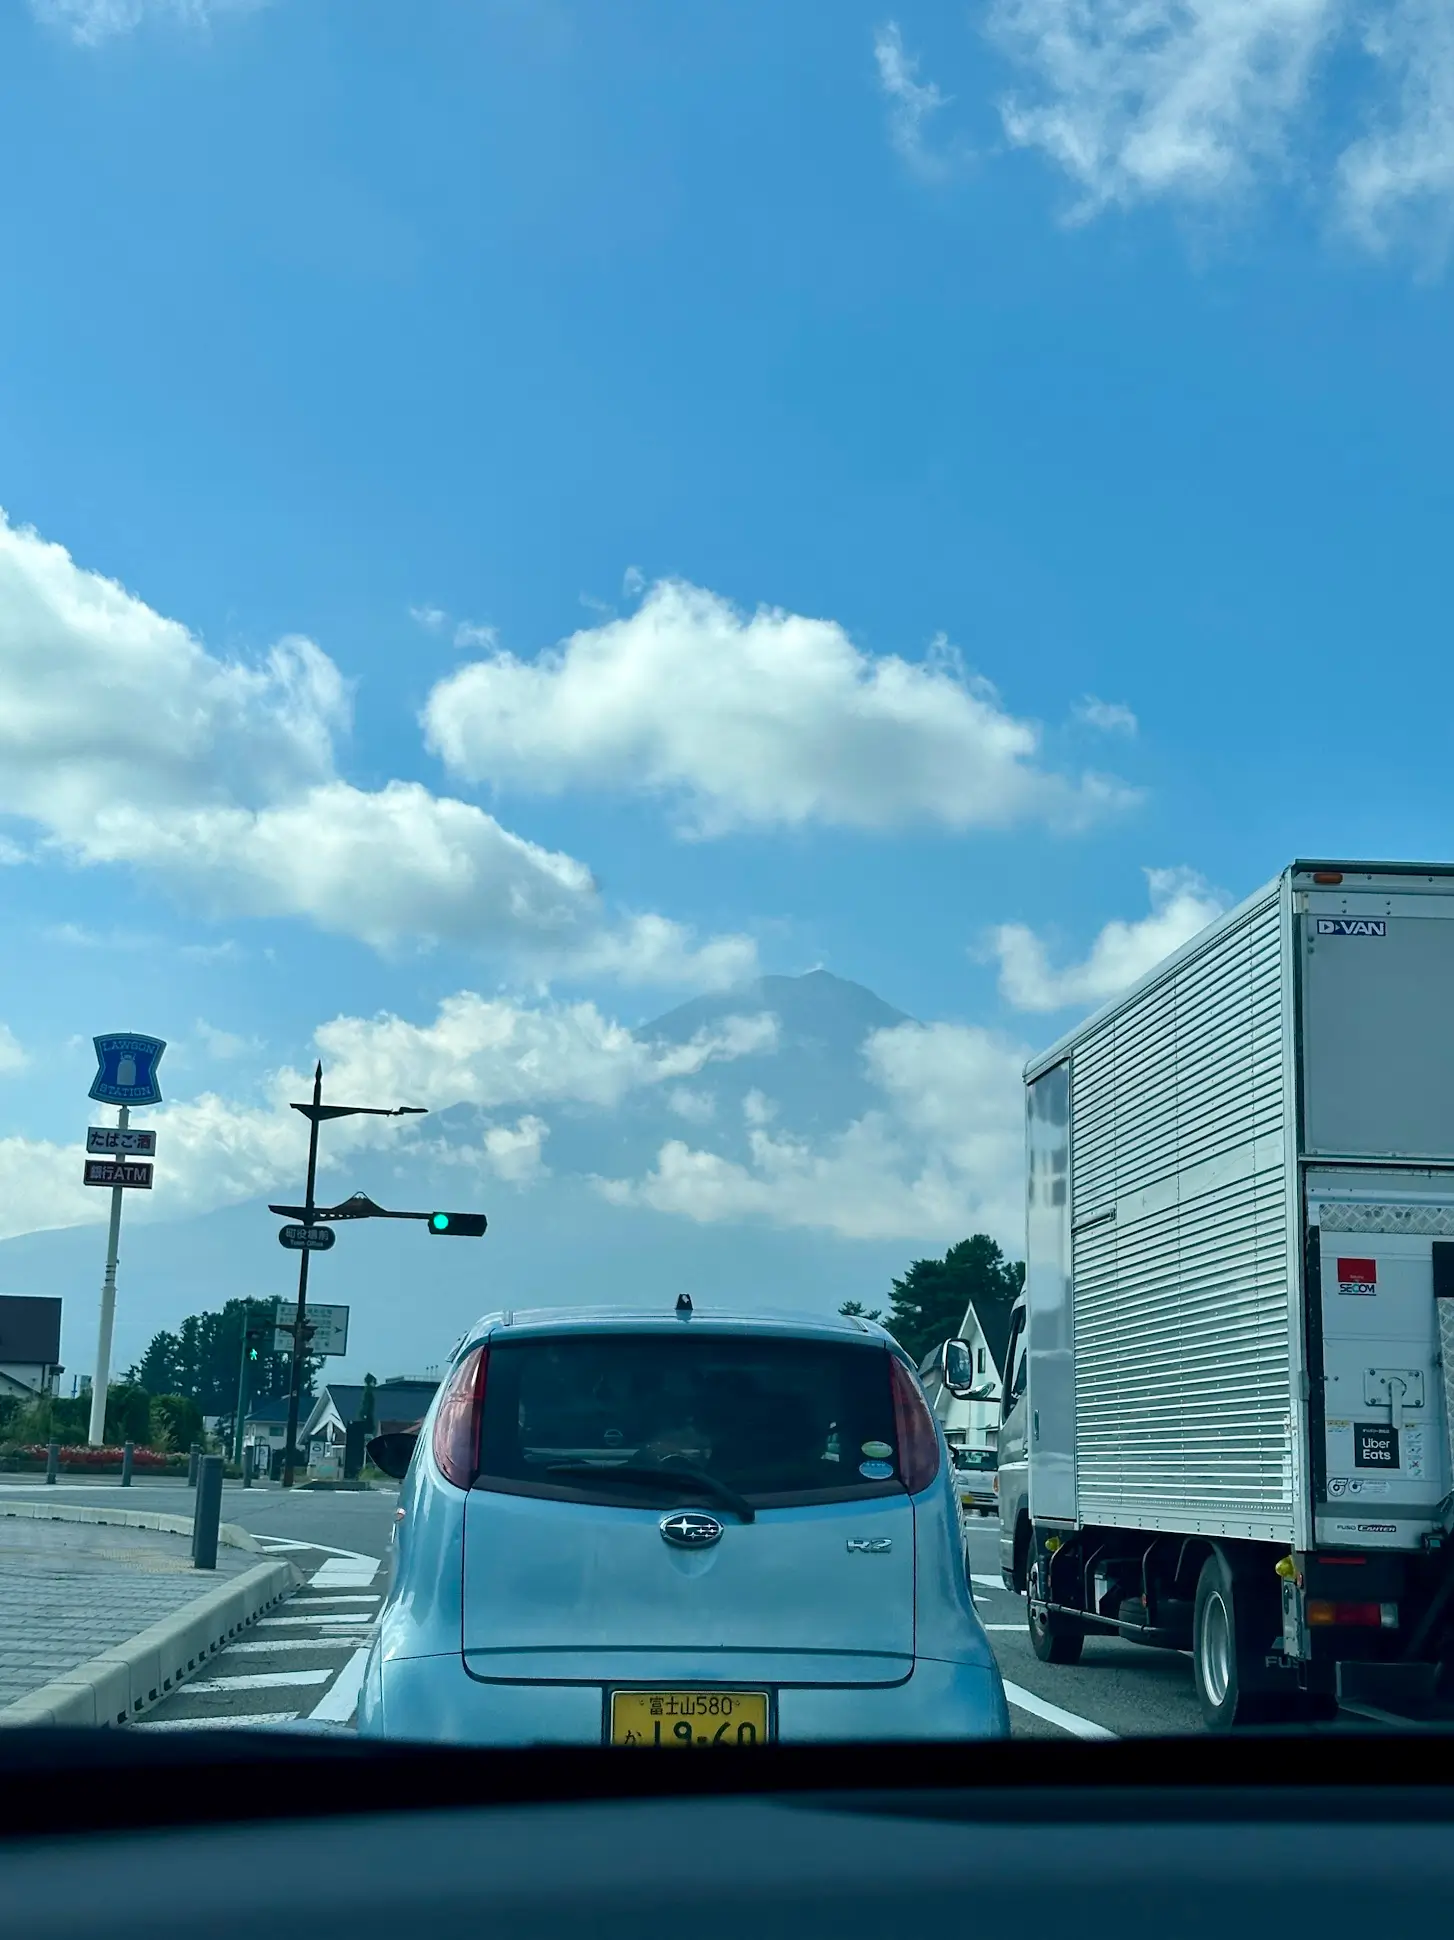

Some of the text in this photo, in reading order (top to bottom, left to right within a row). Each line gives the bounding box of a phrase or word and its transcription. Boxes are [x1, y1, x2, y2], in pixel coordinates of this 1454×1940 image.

[102, 1039, 157, 1054] LAWSON
[99, 1083, 151, 1097] STATION
[90, 1165, 147, 1181] 銀行ATM
[1339, 1283, 1375, 1294] SECOM
[1362, 1437, 1390, 1449] Uber
[1362, 1449, 1391, 1460] Eats
[846, 1538, 892, 1553] R2
